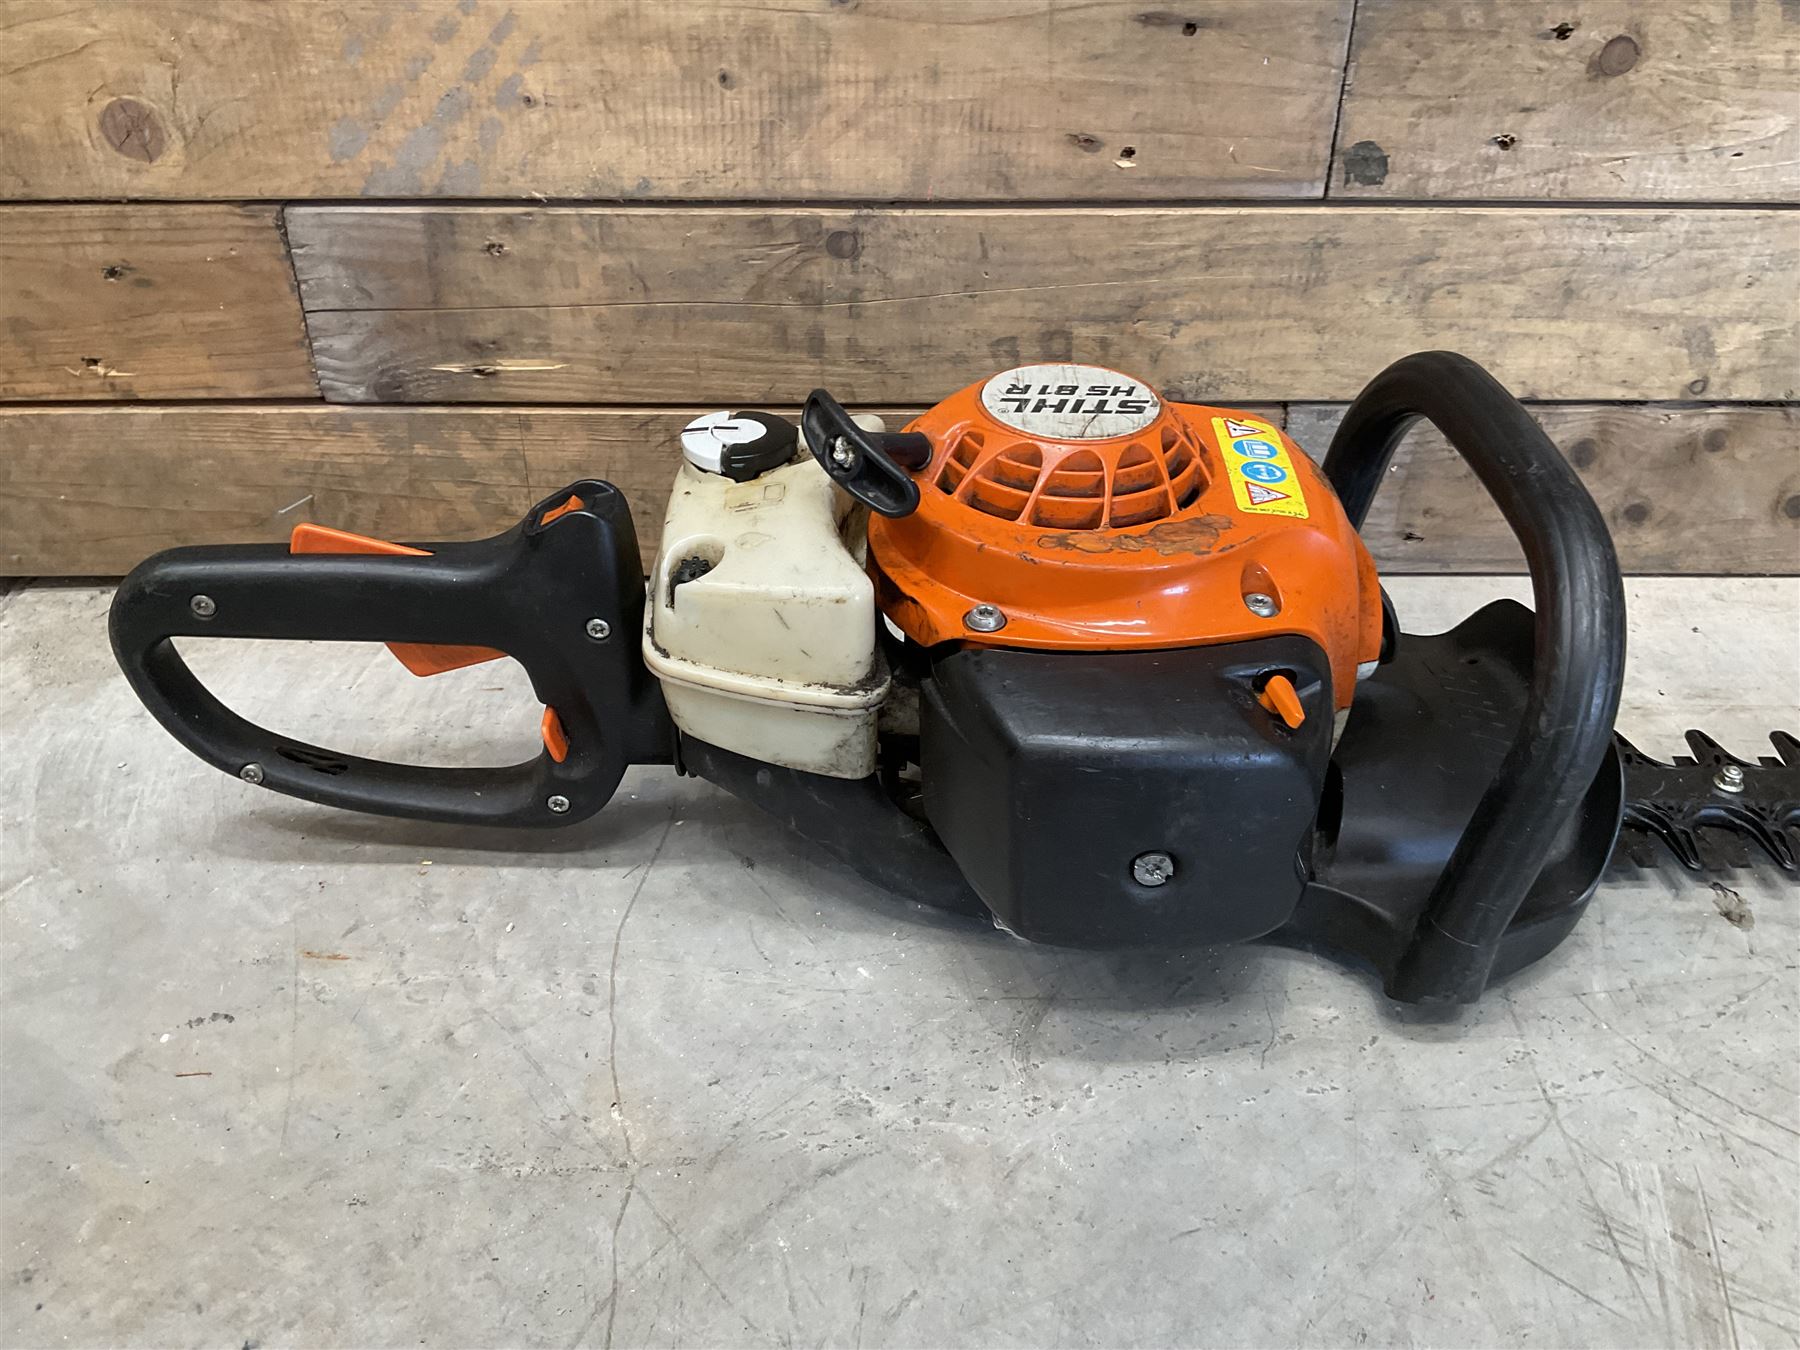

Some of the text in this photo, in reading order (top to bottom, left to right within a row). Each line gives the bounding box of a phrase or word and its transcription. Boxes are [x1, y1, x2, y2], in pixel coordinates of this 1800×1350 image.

[1005, 383, 1137, 397] HS 81 R
[1000, 398, 1152, 414] STIHL
